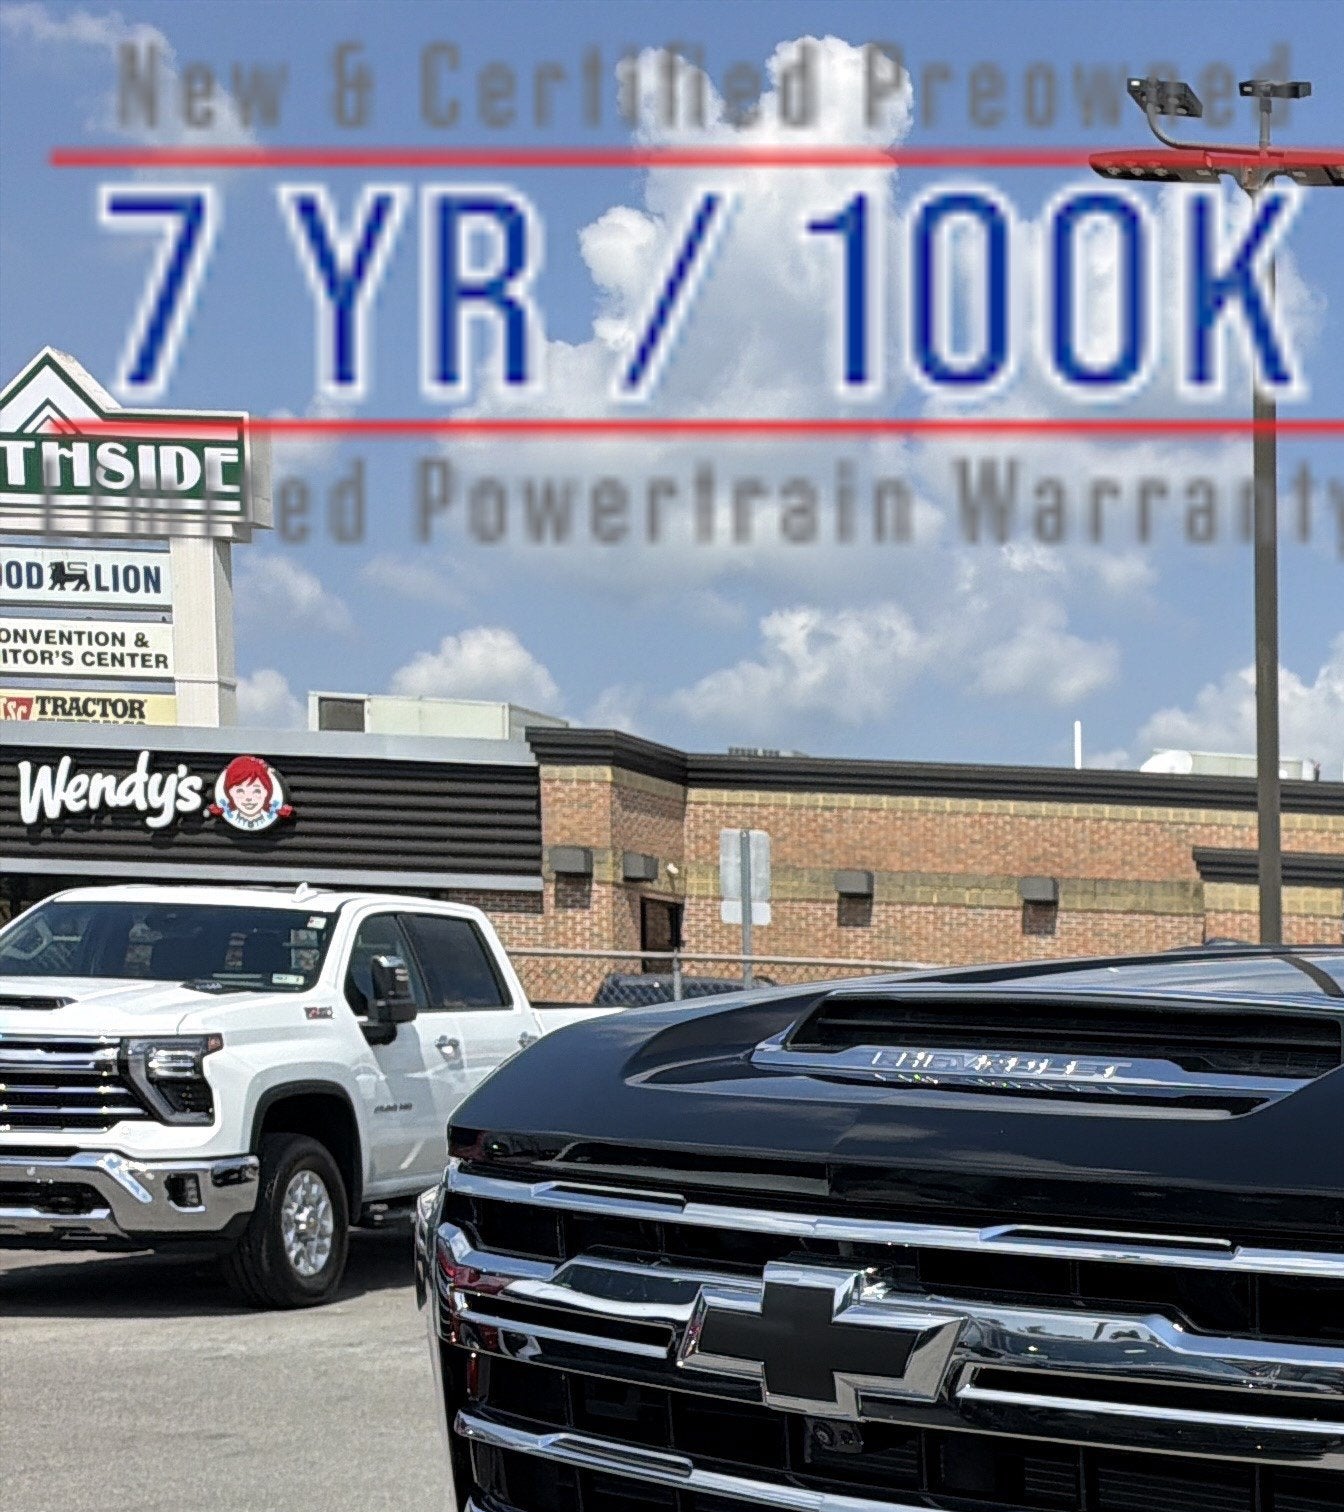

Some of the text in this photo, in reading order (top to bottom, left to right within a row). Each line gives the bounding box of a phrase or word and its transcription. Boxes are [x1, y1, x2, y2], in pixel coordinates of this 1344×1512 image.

[0, 561, 162, 594] OD LION
[134, 632, 150, 648] &
[81, 651, 169, 669] CENTER
[35, 696, 146, 719] TRACTOR
[18, 750, 202, 828] Wendy's
